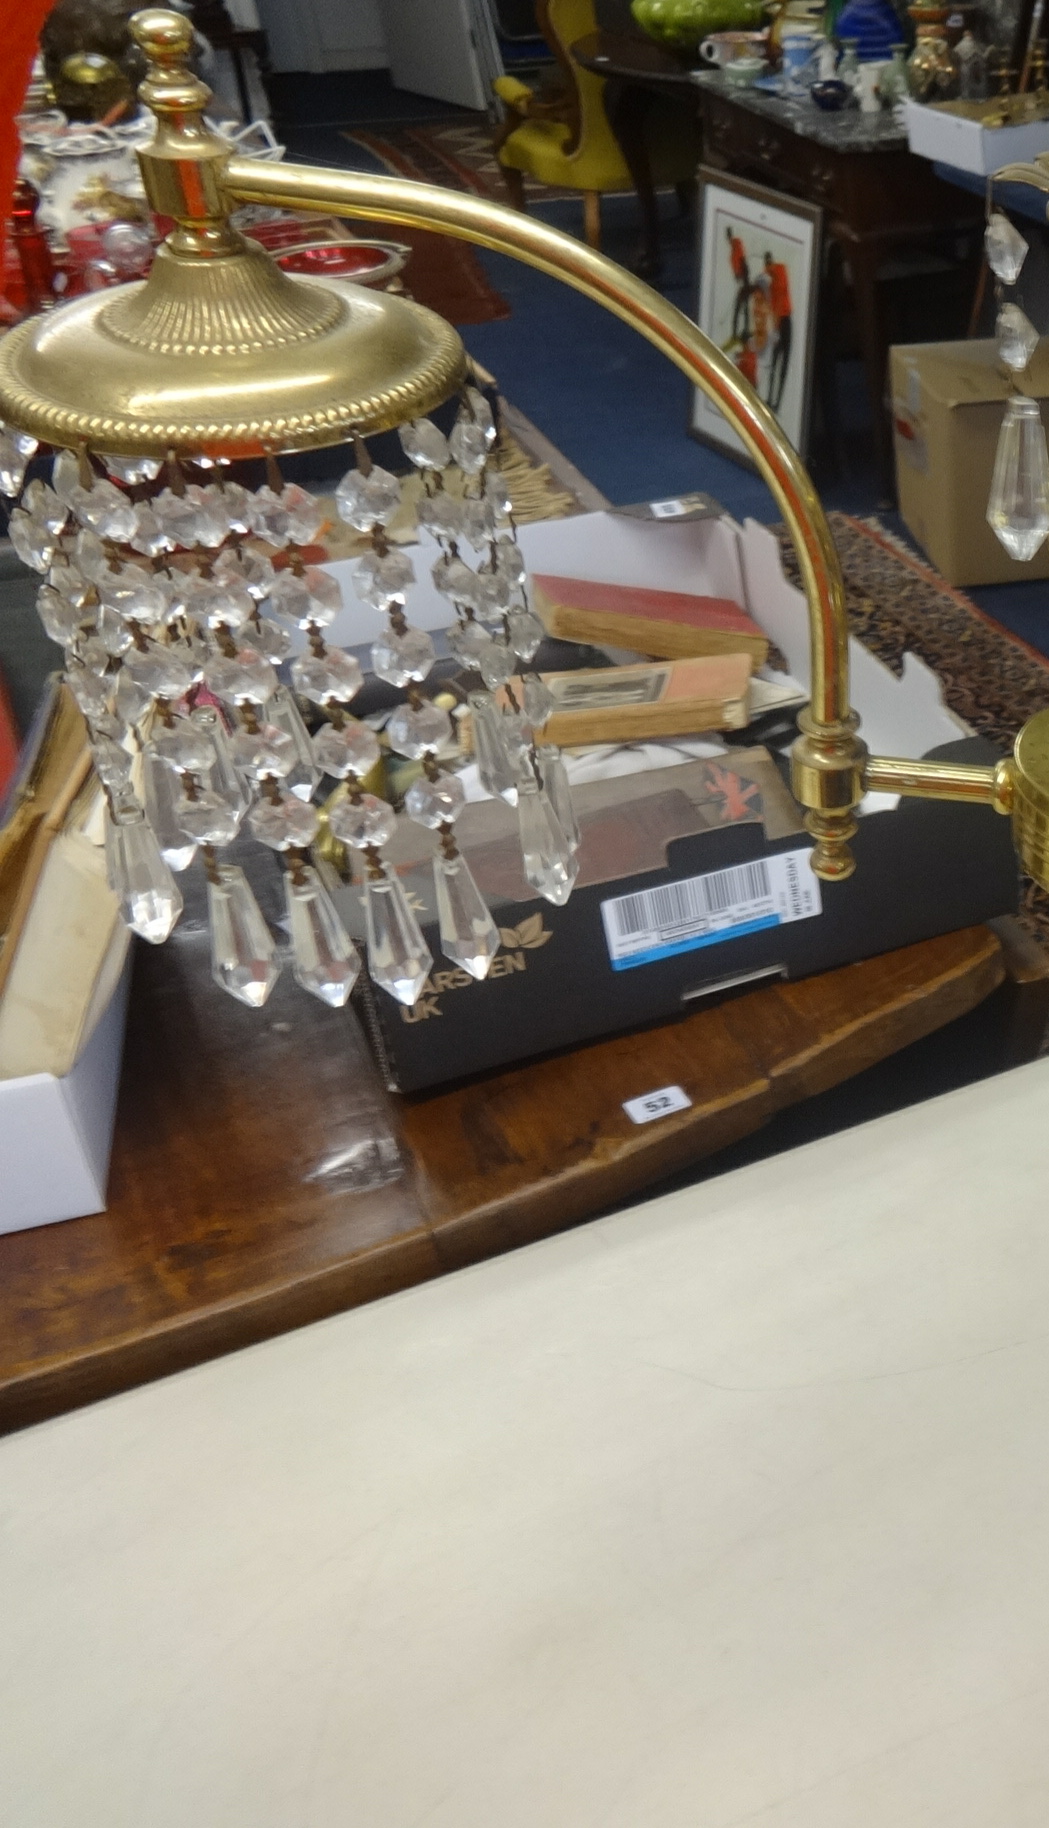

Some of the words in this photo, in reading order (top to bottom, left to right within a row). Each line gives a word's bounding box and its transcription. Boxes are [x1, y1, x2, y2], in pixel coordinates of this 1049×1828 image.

[412, 951, 527, 1001] ARSEN
[401, 996, 443, 1023] UK
[643, 1096, 675, 1112] 52
